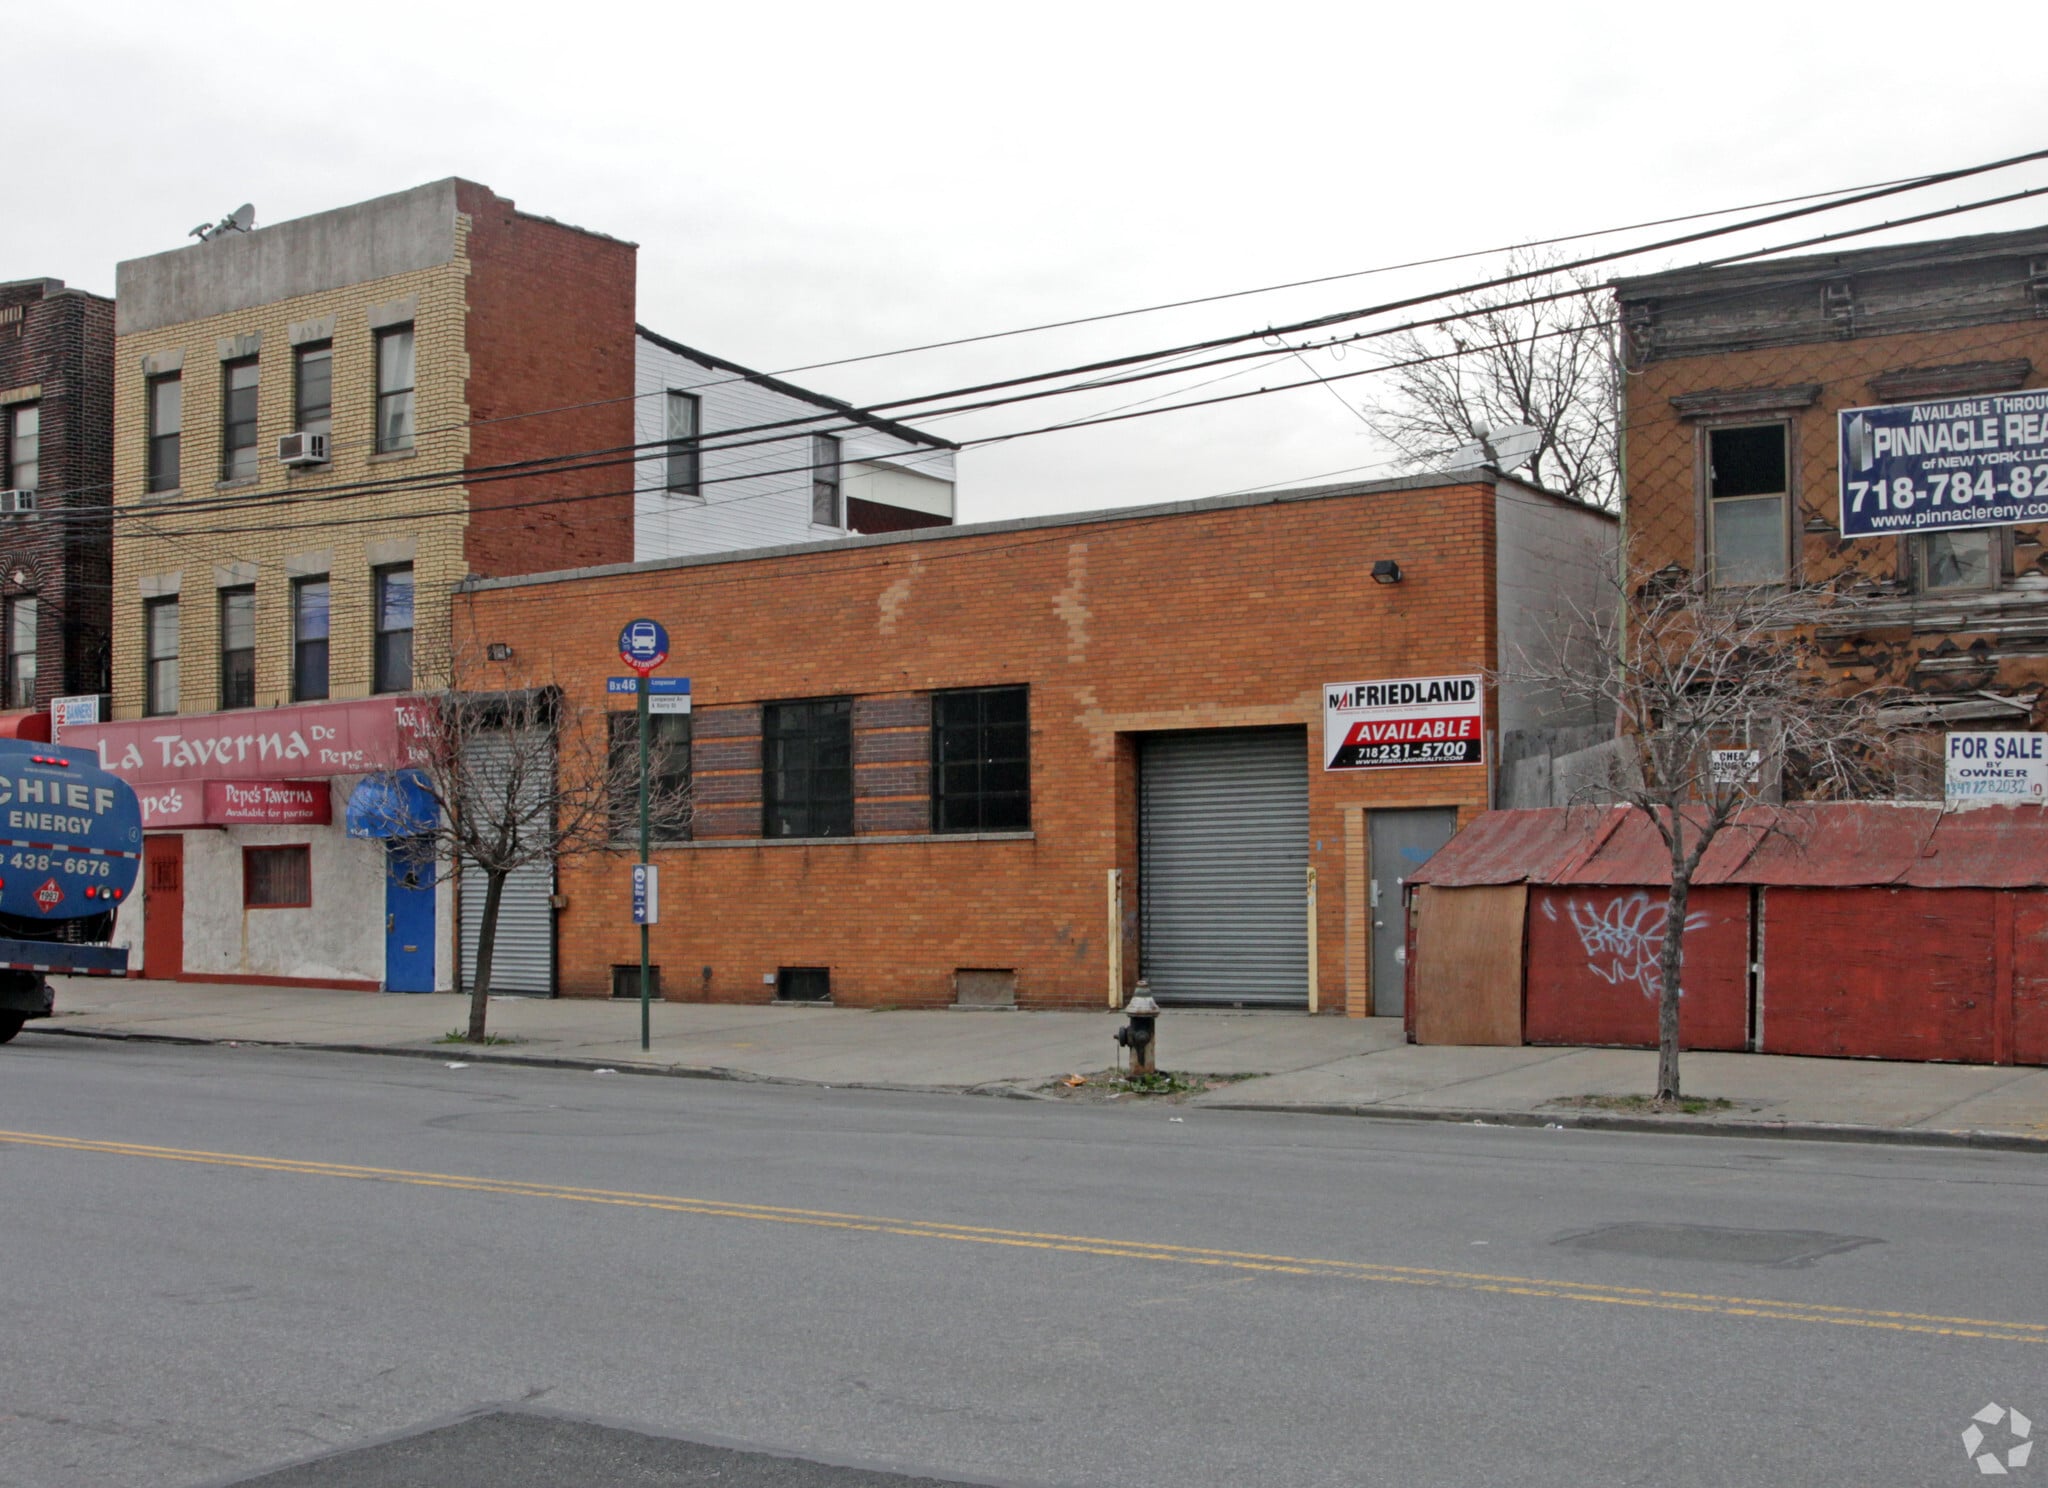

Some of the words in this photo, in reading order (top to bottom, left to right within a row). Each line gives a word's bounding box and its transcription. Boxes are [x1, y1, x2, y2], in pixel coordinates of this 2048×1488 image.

[1911, 400, 1990, 423] AVAILABLE
[1874, 418, 1999, 459] PINNACLE
[1921, 458, 1937, 470] of
[1938, 456, 1975, 468] NEW
[1977, 450, 2020, 465] YORK
[2023, 449, 2048, 460] LLC
[1848, 464, 2048, 513] 718-784-82
[1871, 503, 2048, 528] www.pinnaclereny.co
[609, 679, 636, 691] Bx46
[1329, 688, 1353, 711] NAI
[1355, 680, 1476, 707] FRIEDLAND
[1356, 720, 1472, 742] AVAILABLE
[98, 739, 144, 770] La
[152, 731, 309, 768] Taverna
[310, 725, 336, 740] De
[320, 748, 363, 766] Pepe
[1358, 747, 1379, 758] 718
[1379, 742, 1467, 759] 231-5700
[1951, 737, 1988, 759] FOR
[1994, 737, 2042, 759] SALE
[1960, 769, 2028, 777] OWNER
[225, 784, 261, 807] Pepe's
[263, 787, 313, 804] Taverna
[9, 811, 92, 835] ENERGY
[225, 808, 265, 817] Available
[268, 808, 280, 817] for
[284, 809, 313, 819] parties
[11, 852, 110, 877] 438-6676
[41, 891, 58, 901] 1993
